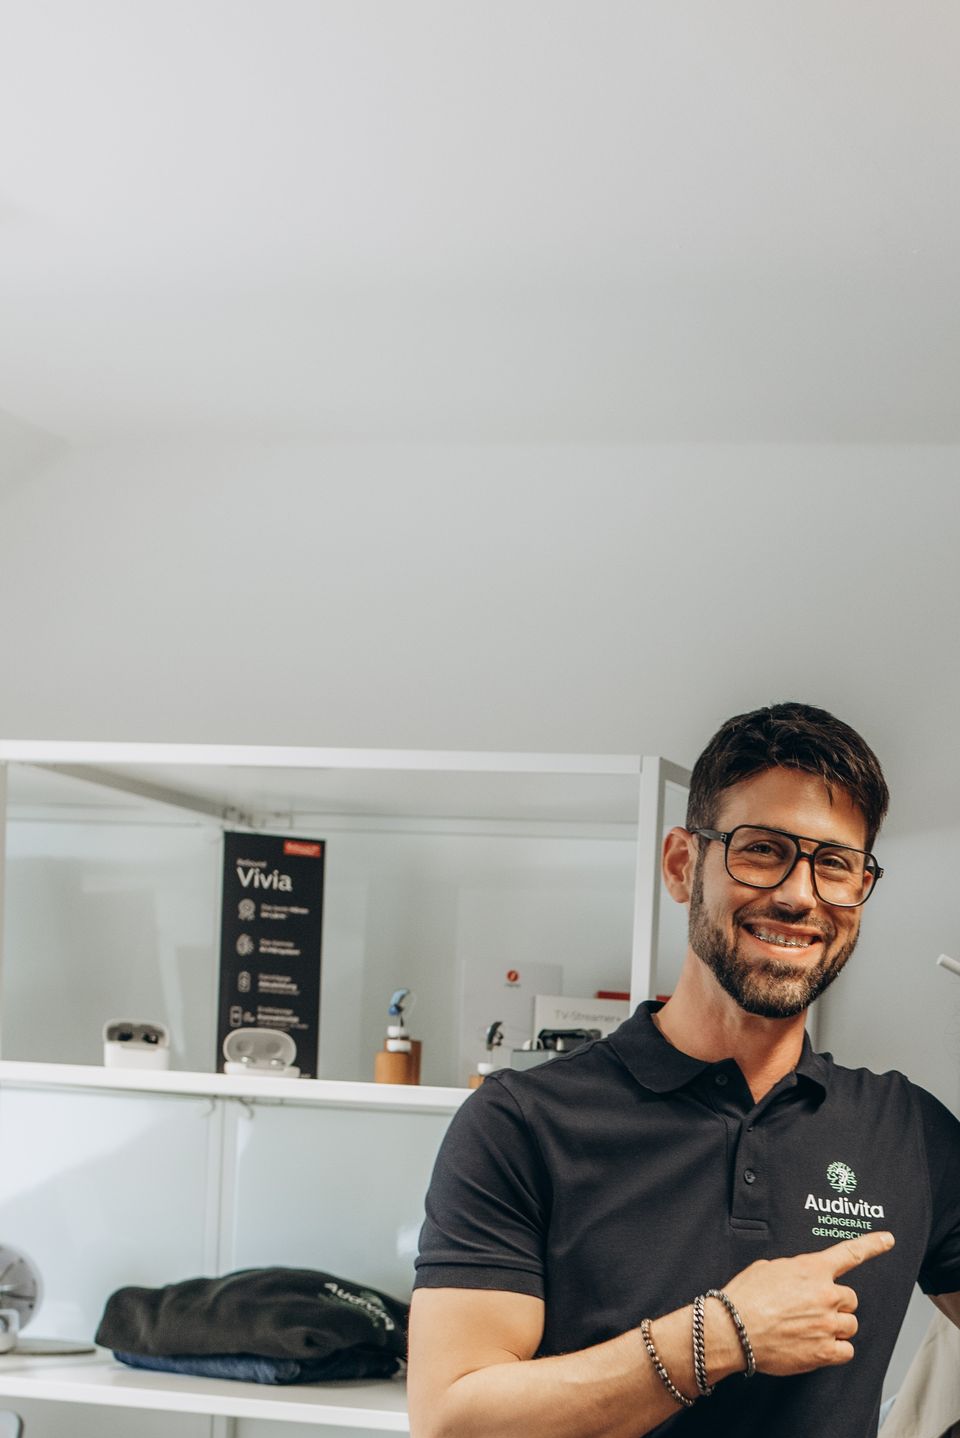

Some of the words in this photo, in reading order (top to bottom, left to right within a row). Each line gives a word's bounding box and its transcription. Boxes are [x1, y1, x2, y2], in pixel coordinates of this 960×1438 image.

[237, 867, 293, 892] Vivia
[804, 1194, 885, 1218] Audivita
[817, 1214, 872, 1230] HÖRGERÄTE
